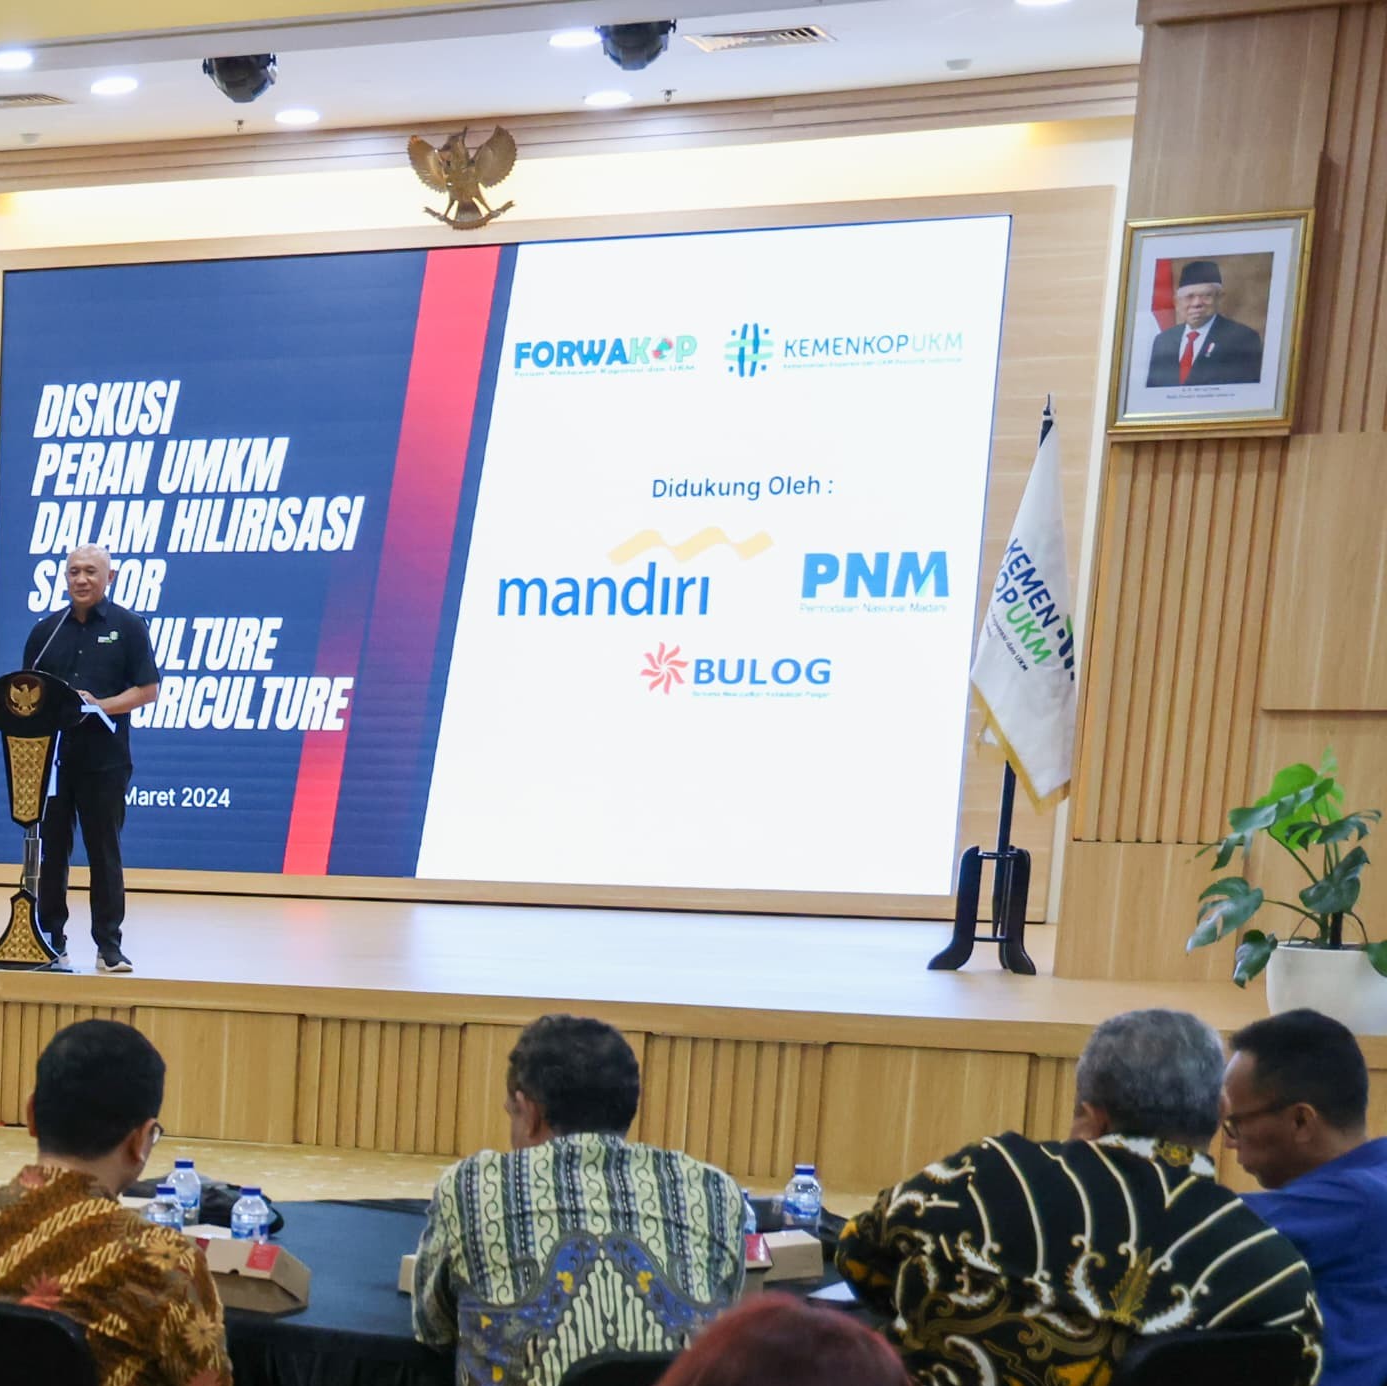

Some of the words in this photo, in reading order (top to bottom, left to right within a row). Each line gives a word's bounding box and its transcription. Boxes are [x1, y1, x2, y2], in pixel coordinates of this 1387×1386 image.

[514, 335, 698, 369] FORWAKOP
[33, 380, 181, 438] DISKUSI
[31, 440, 155, 496] PERAN
[157, 437, 290, 494] UMKM
[652, 478, 760, 501] Didukung
[768, 476, 821, 496] Oleh
[29, 499, 165, 554] DALAM
[167, 496, 365, 552] HILIRISASI
[28, 558, 167, 612] SEOR
[497, 562, 709, 616] mandiri
[802, 551, 950, 598] PNM
[694, 658, 832, 685] BULOG
[181, 787, 230, 808] 2024
